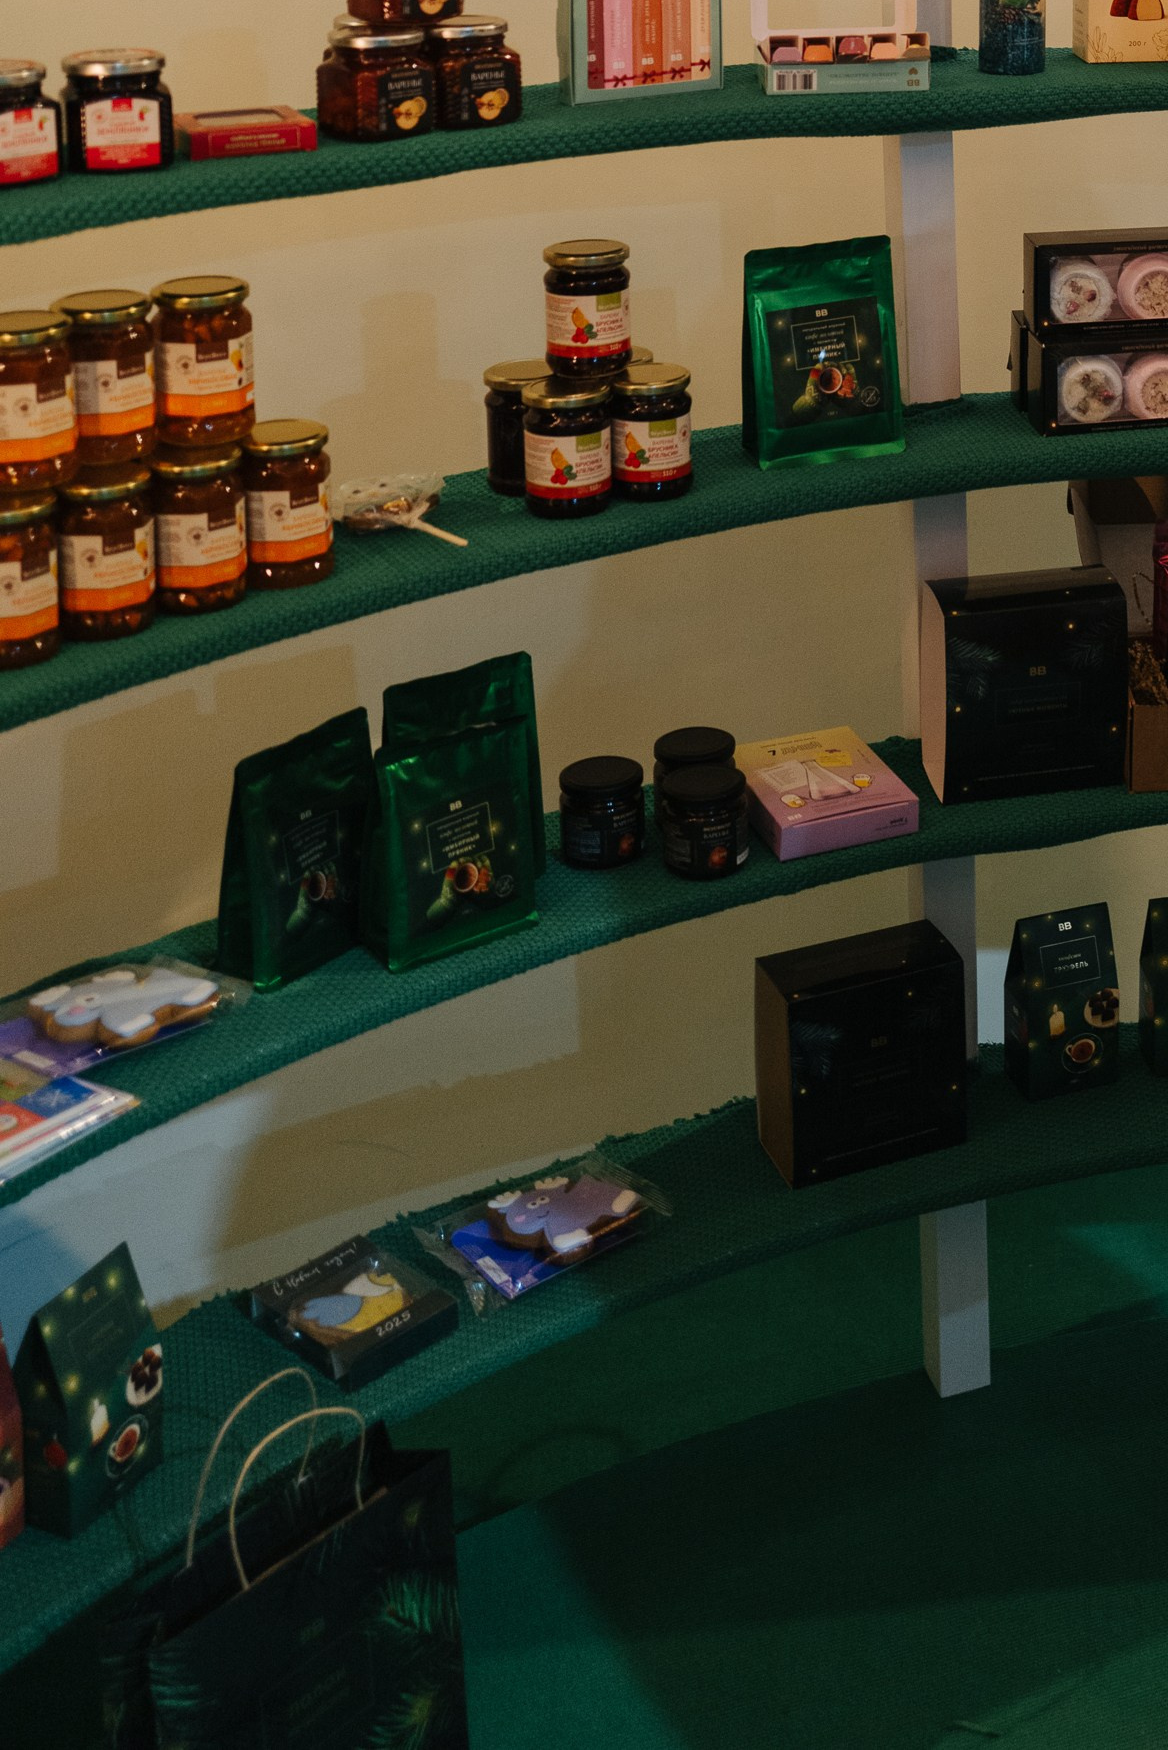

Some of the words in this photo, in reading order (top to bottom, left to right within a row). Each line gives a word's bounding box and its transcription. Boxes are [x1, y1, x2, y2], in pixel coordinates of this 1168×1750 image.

[470, 70, 506, 82] ВАРЕНЬЕ
[388, 78, 422, 90] ВАРЕНЬЕ
[648, 444, 678, 453] БРУСНИКА
[648, 450, 678, 458] АПЕЛЬСИН
[375, 1310, 411, 1337] 2025
